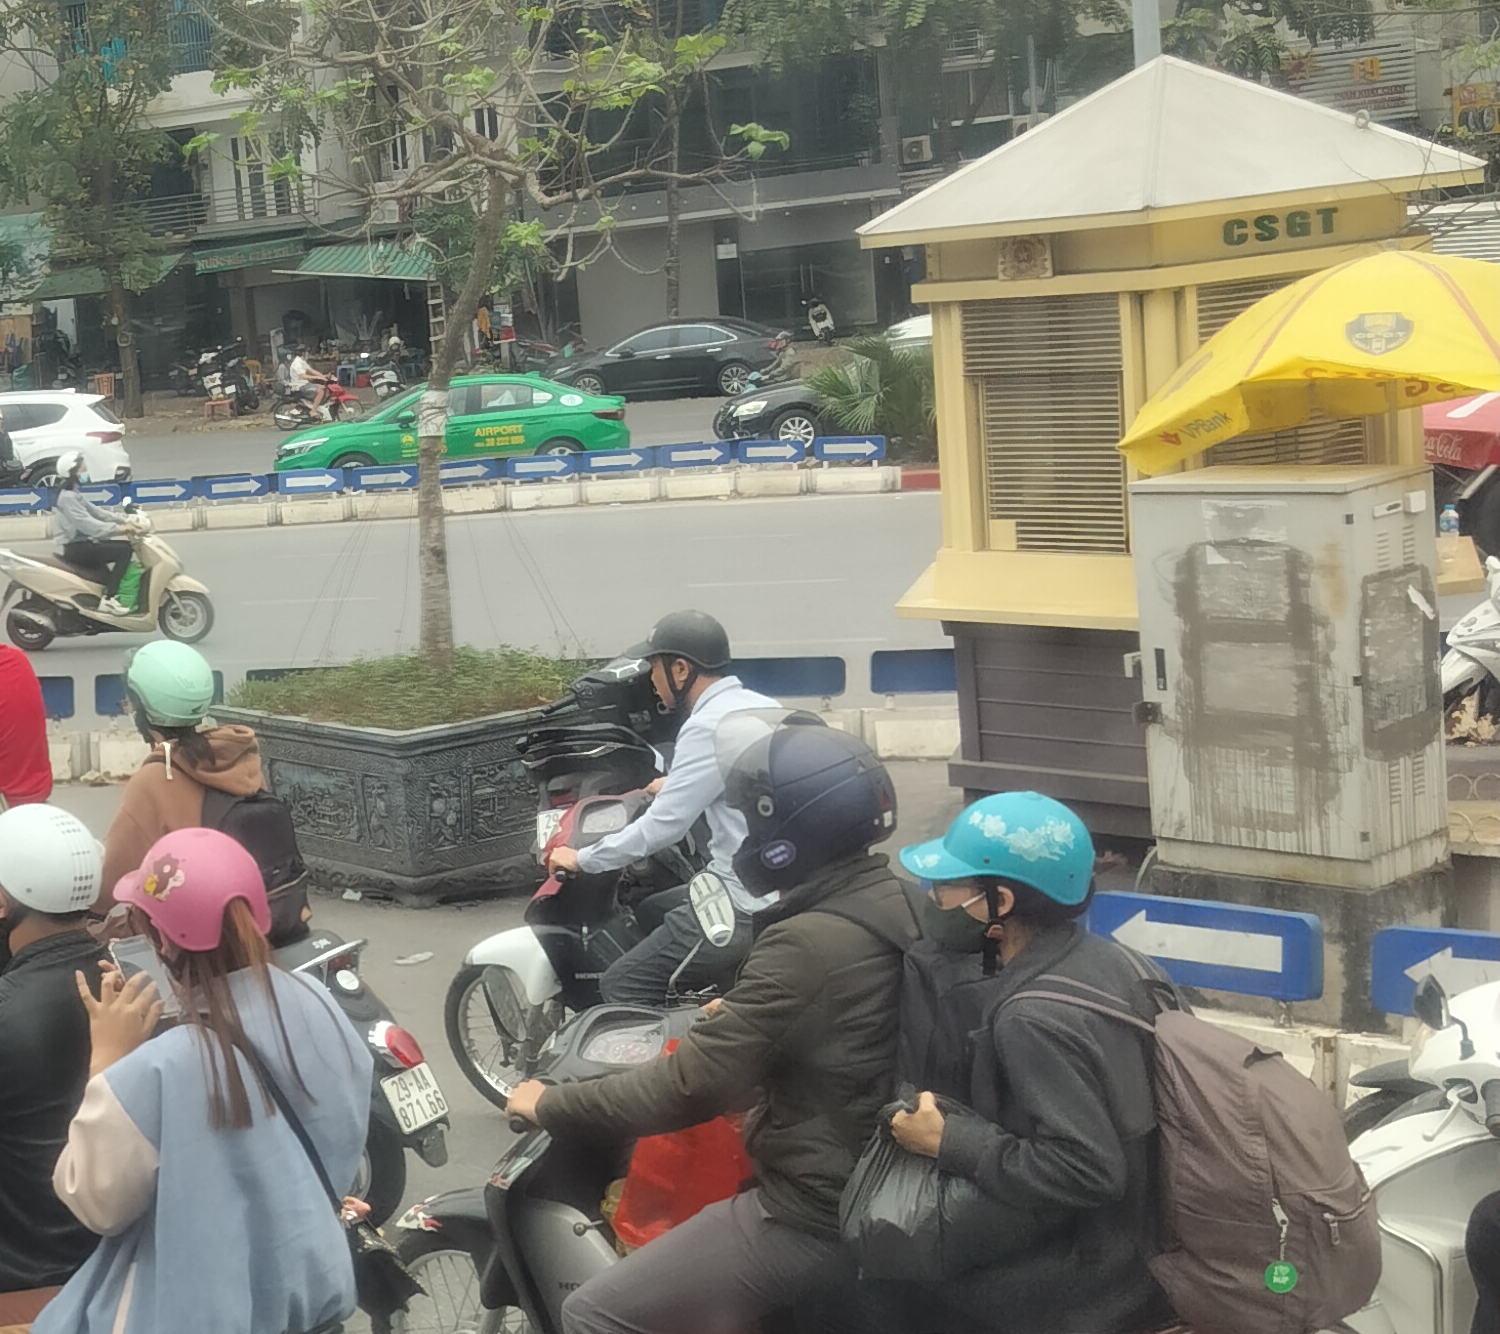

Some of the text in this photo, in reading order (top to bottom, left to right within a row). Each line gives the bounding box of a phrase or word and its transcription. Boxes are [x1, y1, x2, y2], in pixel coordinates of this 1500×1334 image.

[1223, 207, 1339, 247] CSGT
[474, 424, 524, 436] AIRPORT
[1177, 409, 1235, 439] VPBank
[391, 1067, 431, 1102] 29-AA
[399, 1090, 445, 1129] 871.66
